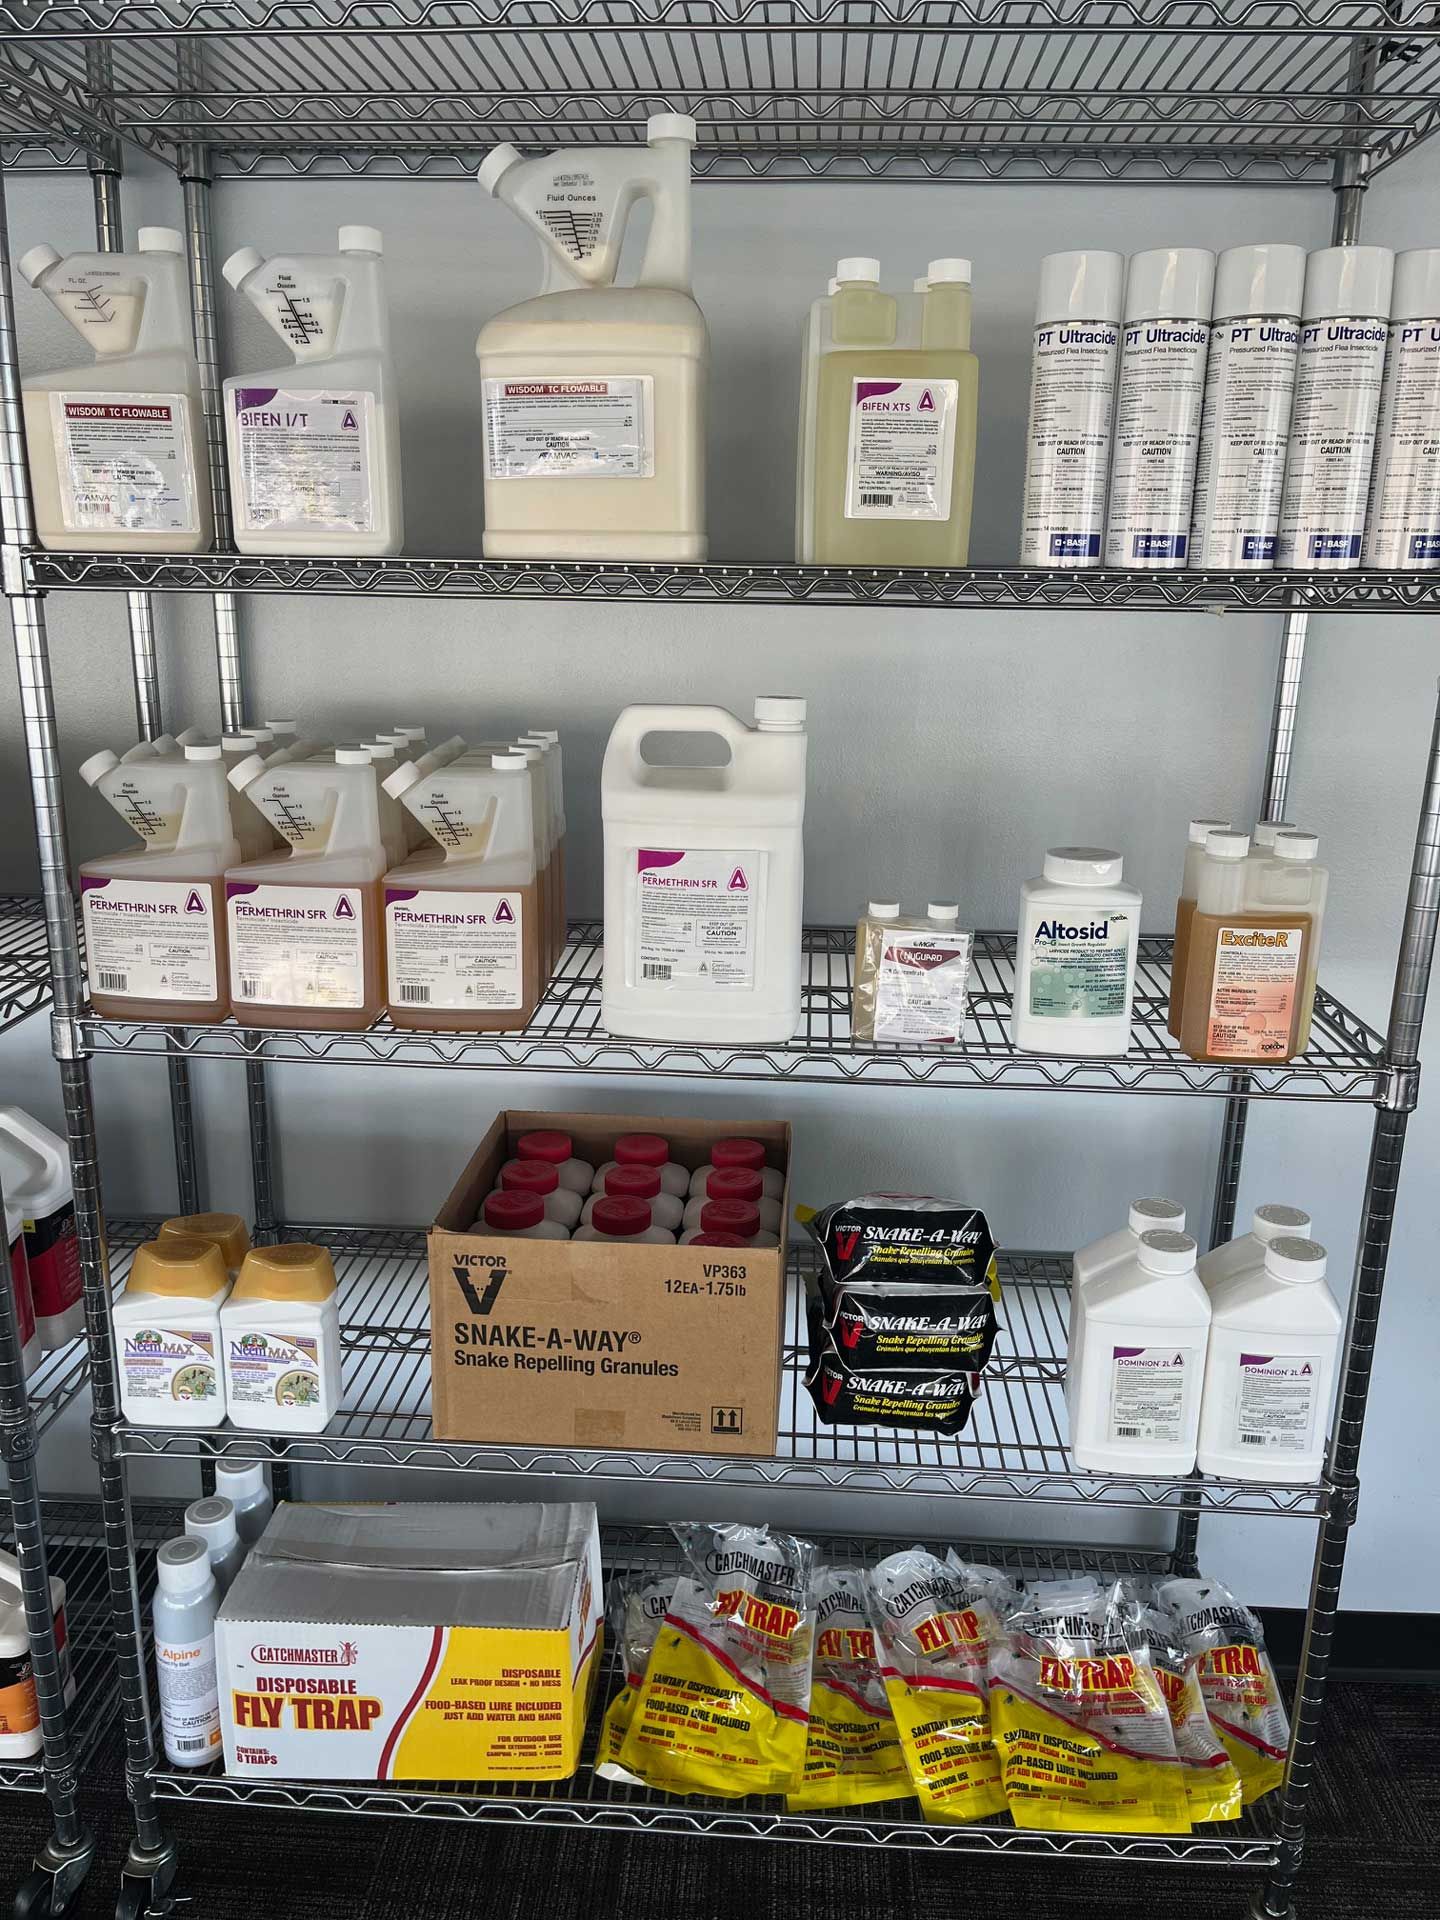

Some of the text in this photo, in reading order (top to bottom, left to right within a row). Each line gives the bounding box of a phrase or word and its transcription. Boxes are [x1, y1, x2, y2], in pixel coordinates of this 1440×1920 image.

[1039, 330, 1116, 347] PT Ultracide
[1126, 329, 1205, 346] PT Ultracide
[1232, 327, 1298, 342] PT Ultraci
[1303, 328, 1386, 343] PT Ultracide
[1402, 329, 1424, 342] PT
[1081, 347, 1108, 355] Insecticide
[508, 386, 544, 394] WISDOM
[561, 385, 606, 393] FLOWABLE
[68, 407, 168, 418] WISDOM TC FLOWABLE
[862, 403, 911, 412] BIFEN XTS
[242, 412, 308, 427] BIFEN I/T
[1067, 539, 1088, 547] BASF
[1150, 540, 1172, 548] BASF
[643, 876, 718, 888] PERMETHRIN SFR
[90, 900, 178, 914] PERMETHRIN SFR
[236, 906, 327, 919] PERMETHRIN SFR
[394, 912, 486, 924] PERMETHRIN SFR
[1035, 921, 1108, 940] Altosid
[1221, 930, 1289, 947] ExciteR
[835, 1225, 862, 1233] VICTOR
[864, 1226, 982, 1245] SNAKE-A-WAY
[872, 1245, 943, 1258] Snake Repelling
[454, 1254, 507, 1268] VICTOR
[702, 1264, 747, 1279] VP363
[664, 1279, 746, 1297] 12EA-1.75lb
[124, 1338, 195, 1356] Neem MAX
[877, 1335, 905, 1344] Snake
[906, 1336, 949, 1346] Repelling
[230, 1341, 299, 1362] Neem MAX
[454, 1350, 679, 1377] Snake Repelling Granules
[1245, 1367, 1287, 1375] DOMINION
[854, 1395, 881, 1406] Snake
[882, 1398, 925, 1411] Repelling
[715, 1551, 796, 1587] CATCHMASTER
[745, 1595, 798, 1638] TRAP
[916, 1615, 952, 1651] FLY
[163, 1649, 201, 1661] Alpine
[259, 1647, 338, 1663] CATCHMASTER
[1211, 1647, 1261, 1676] TRA
[502, 1669, 560, 1678] DISPOSABLE
[1079, 1656, 1135, 1689] TRAP
[256, 1677, 357, 1695] DISPOSABLE
[653, 1673, 744, 1700] SANITARY DISPOSABILITY
[235, 1694, 382, 1730] FLY TRAP
[425, 1701, 562, 1711] FOOD-BASED LURE INCLUDED
[182, 1715, 212, 1726] CAUTION
[444, 1712, 464, 1720] JUST
[538, 1713, 562, 1721] HANG
[646, 1699, 689, 1716] FOOD-BASED
[712, 1713, 750, 1731] INCLUDED
[911, 1720, 948, 1738] SANITARY
[236, 1746, 269, 1755] CONTAINS:
[1043, 1735, 1102, 1758] DISPOSABILITY
[244, 1754, 278, 1765] TRAPS
[920, 1745, 966, 1766] FOOD-BASED
[957, 1771, 969, 1781] USE
[1017, 1768, 1030, 1776] ADD
[1032, 1770, 1052, 1781] WATER
[1054, 1775, 1068, 1785] AND
[1056, 1763, 1076, 1776] LURE
[1078, 1769, 1118, 1781] INCLUDED
